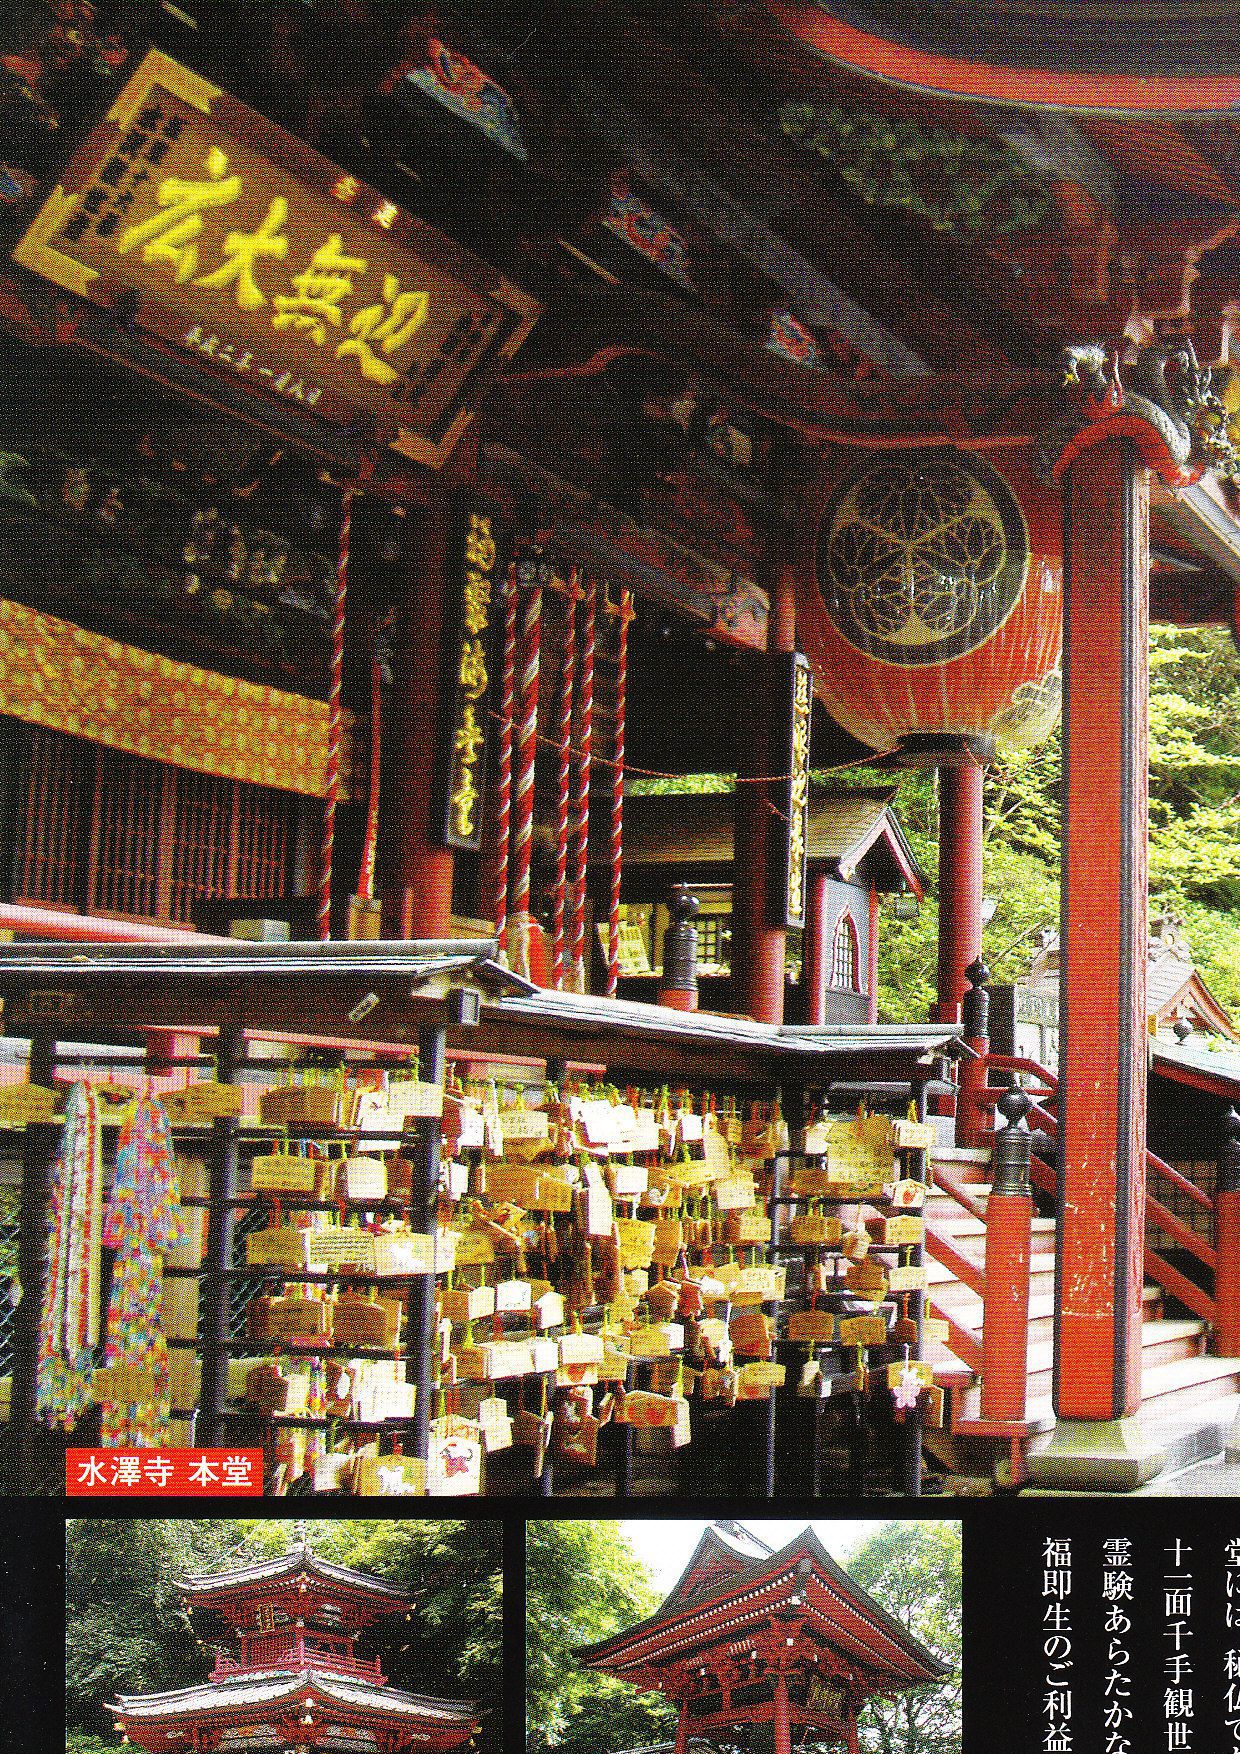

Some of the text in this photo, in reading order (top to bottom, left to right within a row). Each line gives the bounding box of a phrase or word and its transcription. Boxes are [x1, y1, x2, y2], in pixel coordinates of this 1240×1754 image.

[77, 1456, 252, 1486] 水澤寺 本堂
